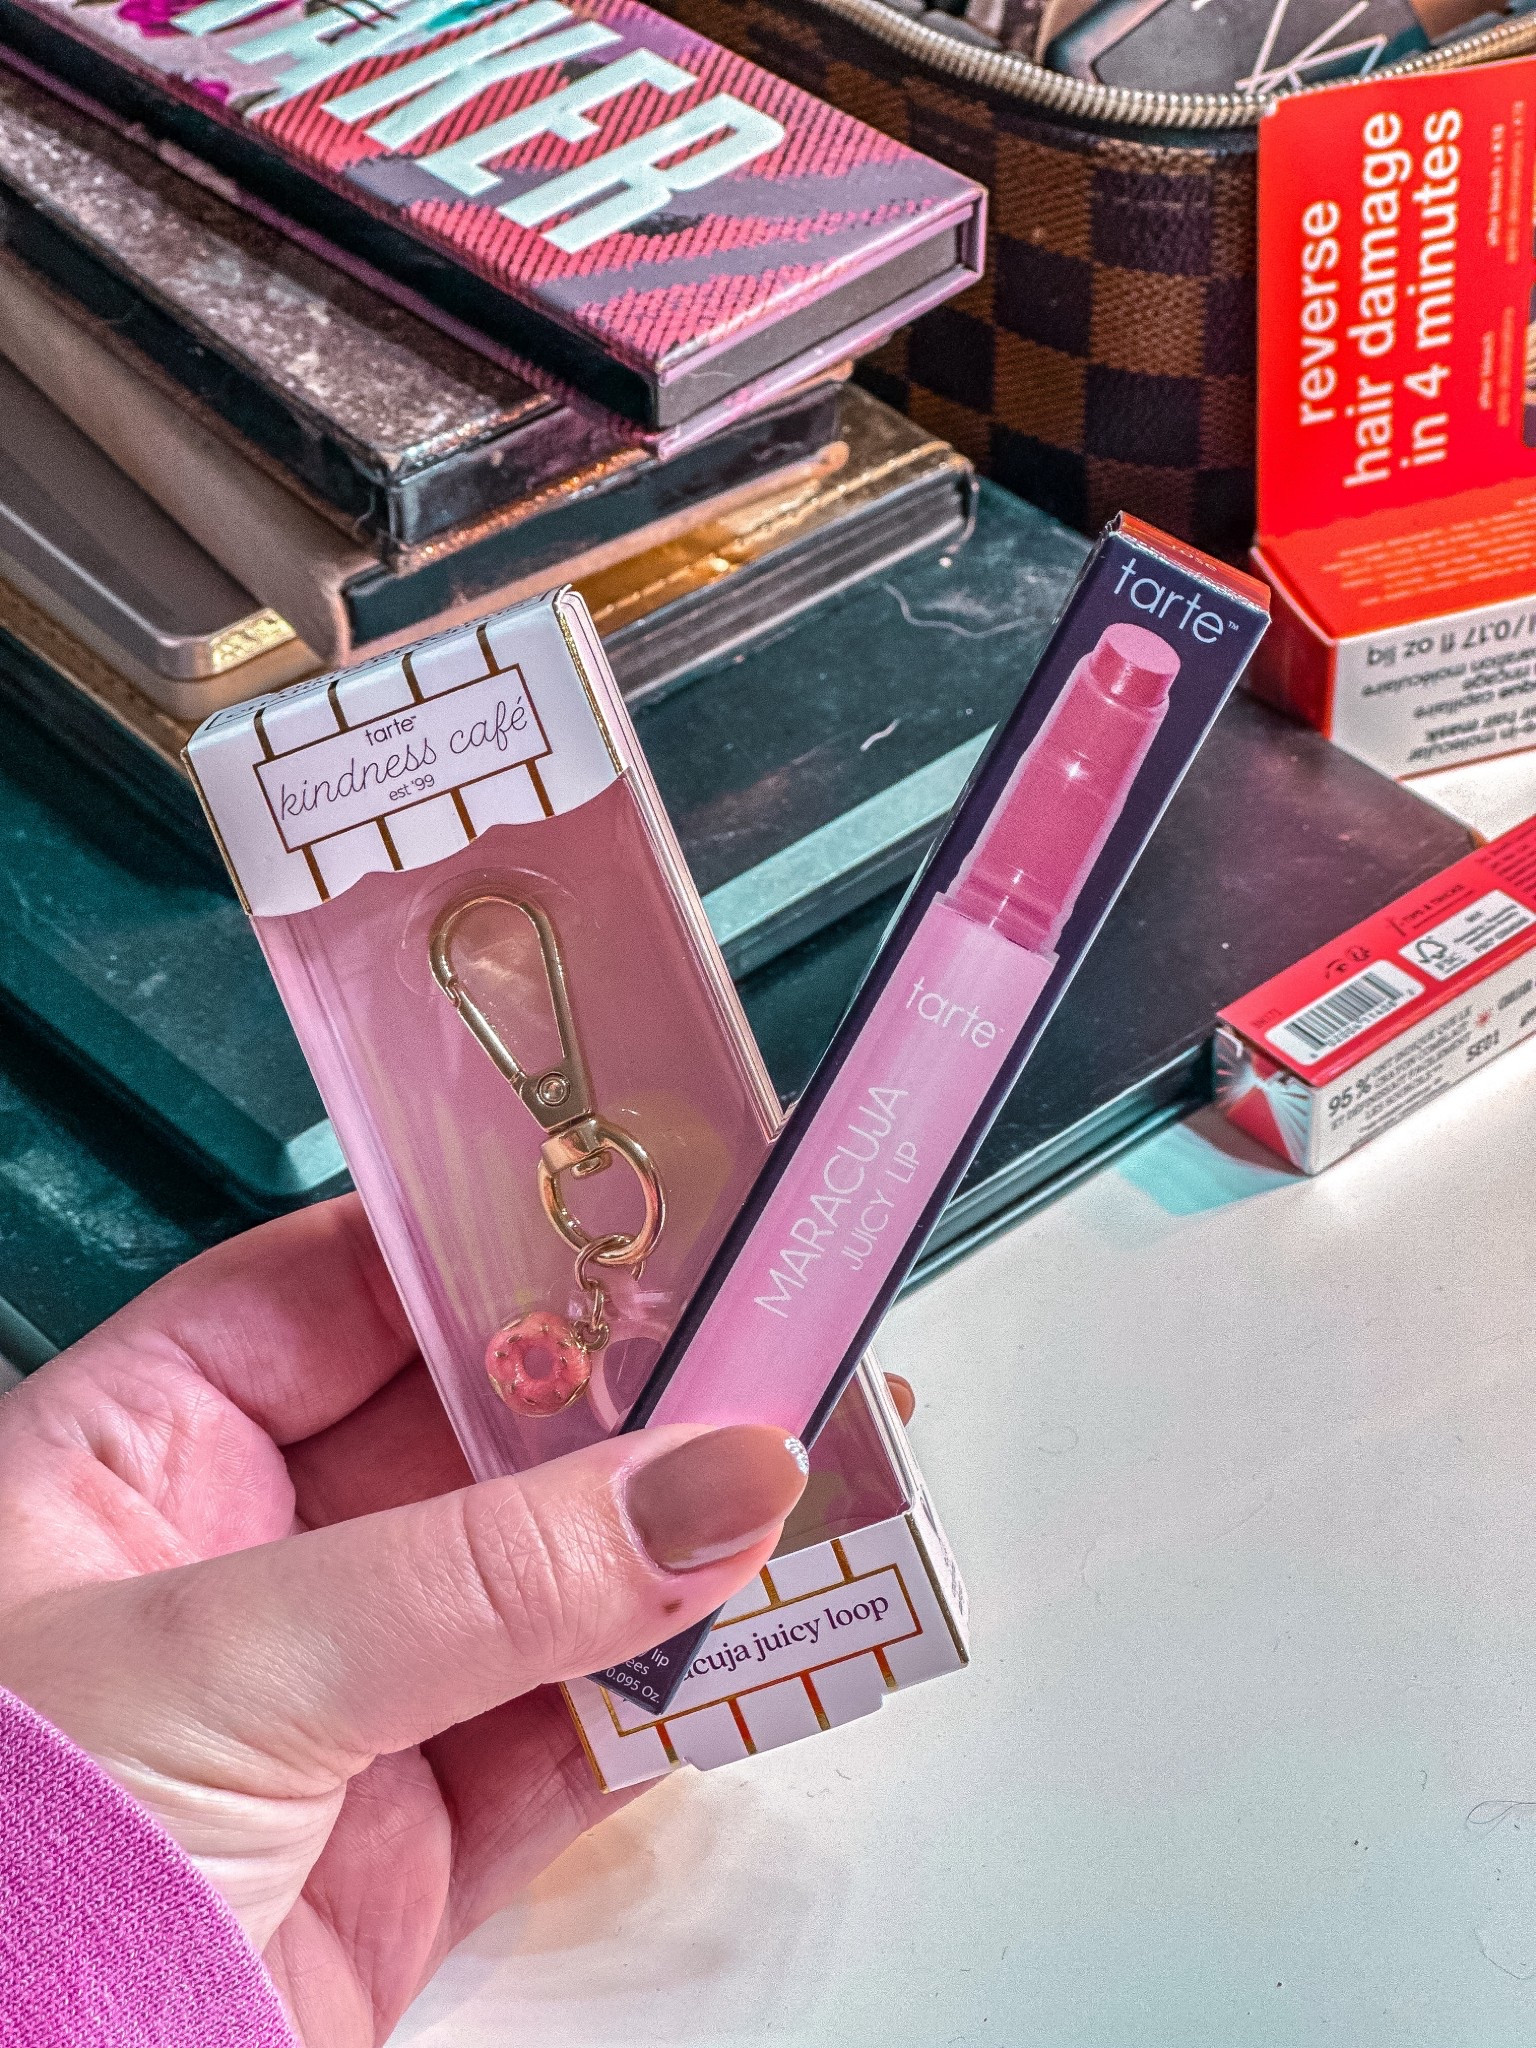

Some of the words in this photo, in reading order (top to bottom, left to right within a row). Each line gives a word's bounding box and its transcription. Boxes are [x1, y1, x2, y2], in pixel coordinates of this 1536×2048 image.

[172, 0, 784, 254] AKER
[1347, 111, 1412, 358] damage
[1406, 107, 1463, 351] minutes
[1300, 200, 1341, 427] reverse
[1342, 374, 1394, 489] hair
[1404, 362, 1451, 399] 4
[1399, 412, 1450, 469] in
[278, 737, 437, 820] kindness
[449, 695, 528, 755] café
[389, 784, 412, 801] est
[754, 1086, 908, 1319] MARACUJA
[841, 1188, 896, 1272] JUICY
[885, 1140, 920, 1184] LIP
[605, 1667, 641, 1691] 0.095
[625, 1658, 651, 1676] ees
[651, 1648, 670, 1668] lip
[753, 1615, 821, 1661] juicy
[823, 1595, 890, 1631] loop
